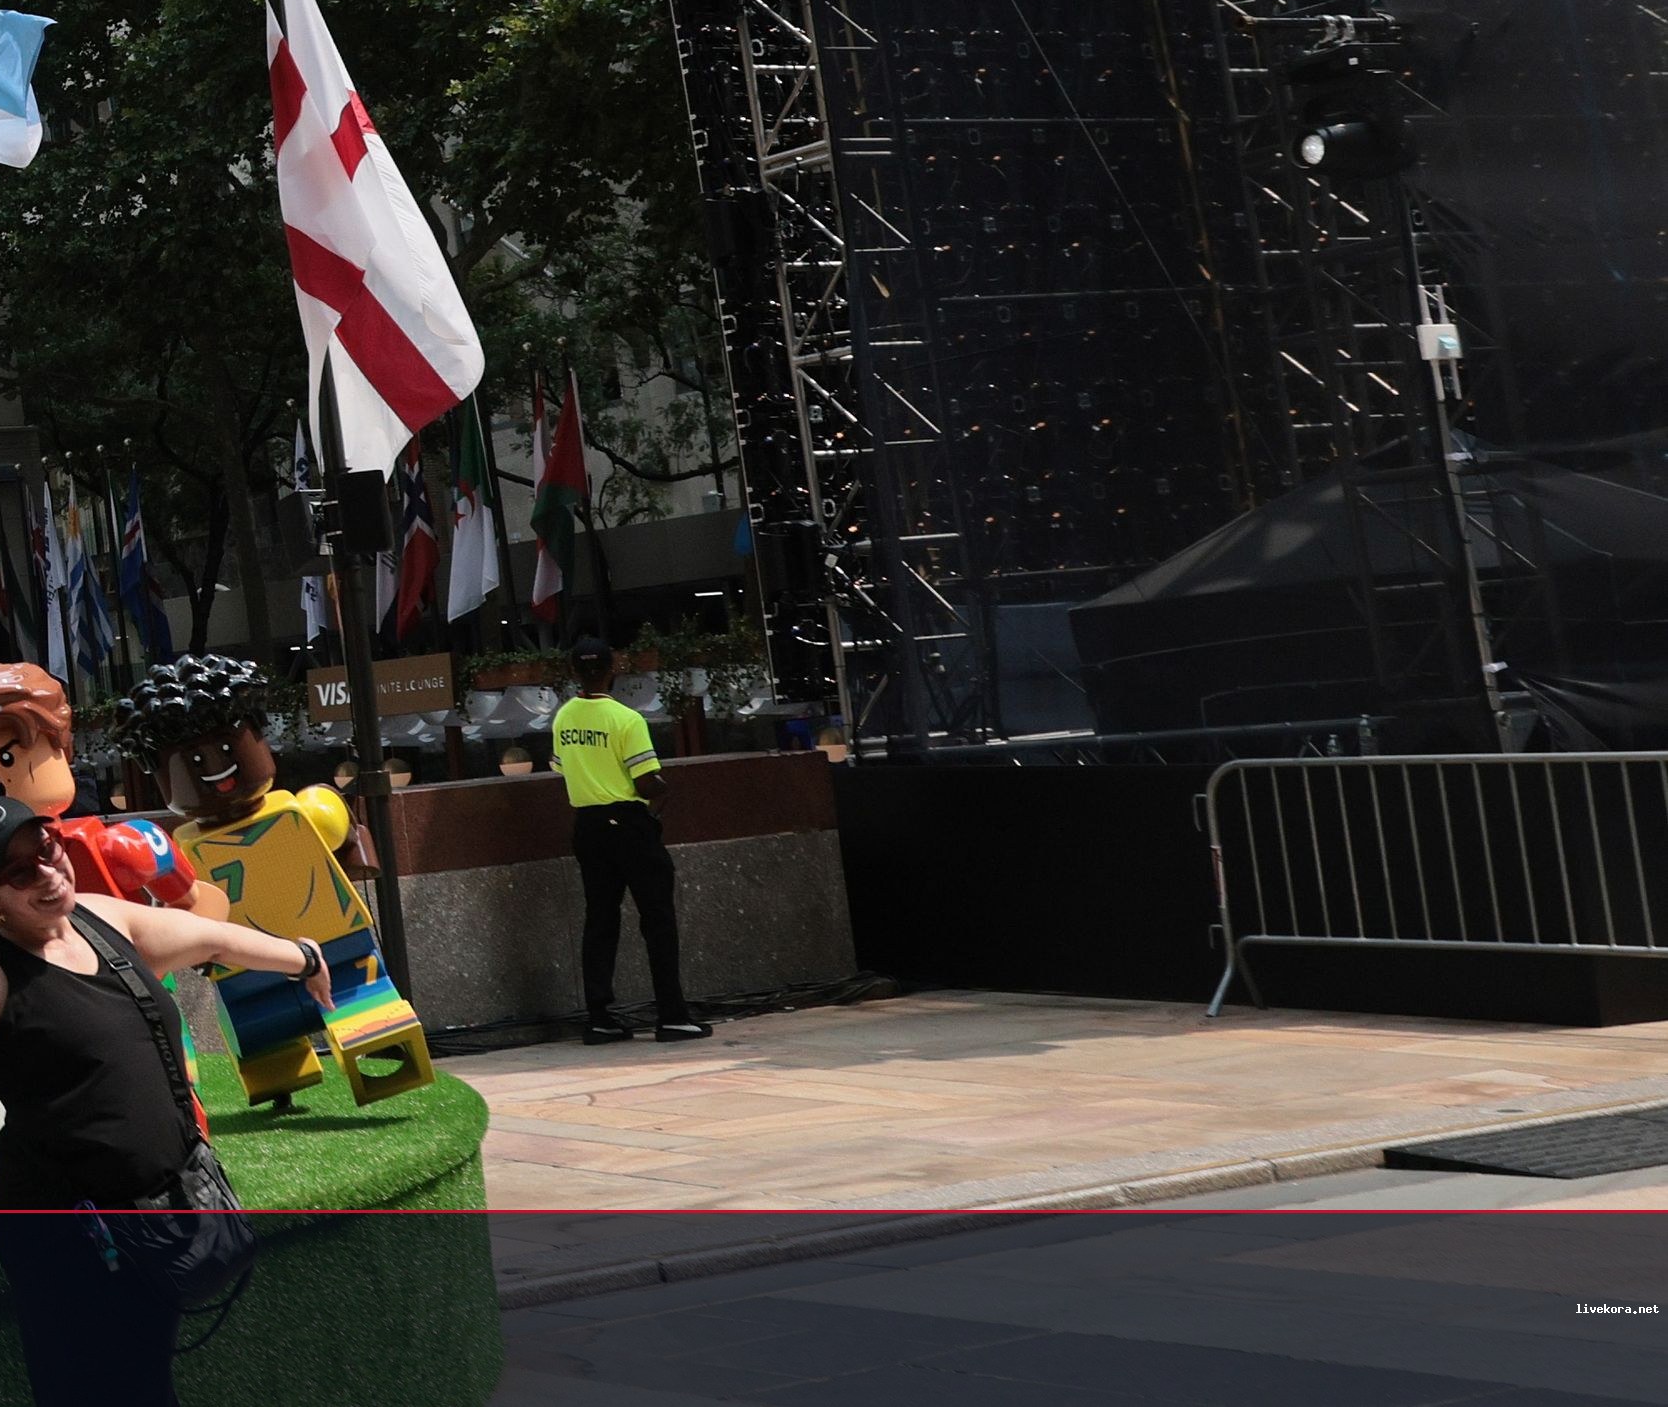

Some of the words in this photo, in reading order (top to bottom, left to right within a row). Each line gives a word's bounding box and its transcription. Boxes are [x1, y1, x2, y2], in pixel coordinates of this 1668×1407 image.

[315, 681, 351, 707] VIS
[404, 676, 445, 692] LOUNGE
[560, 728, 609, 749] SECURITY
[211, 859, 245, 904] 7
[354, 954, 378, 986] 7
